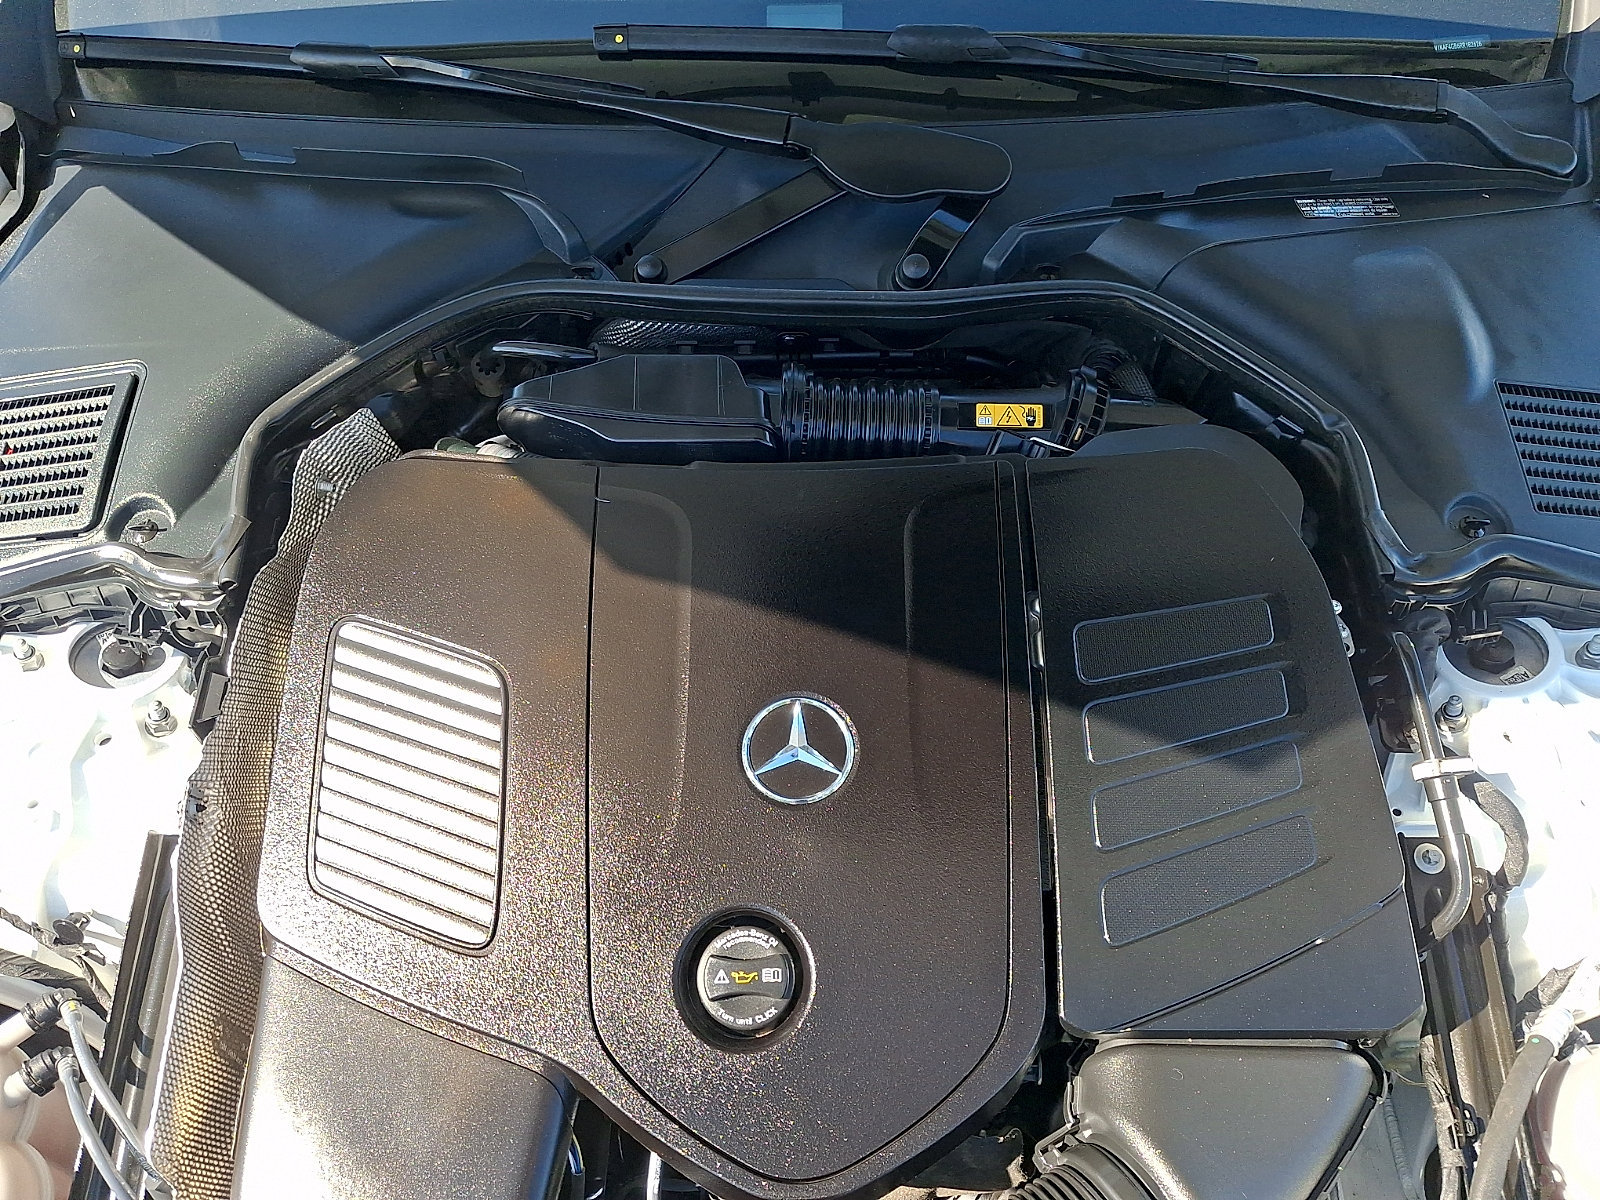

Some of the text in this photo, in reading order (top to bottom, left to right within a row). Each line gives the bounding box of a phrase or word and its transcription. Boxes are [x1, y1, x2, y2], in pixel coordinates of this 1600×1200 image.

[714, 928, 769, 949] Mercedes-Benz
[723, 936, 770, 950] recommended
[718, 1008, 734, 1023] Turn
[755, 1006, 779, 1024] CLICK
